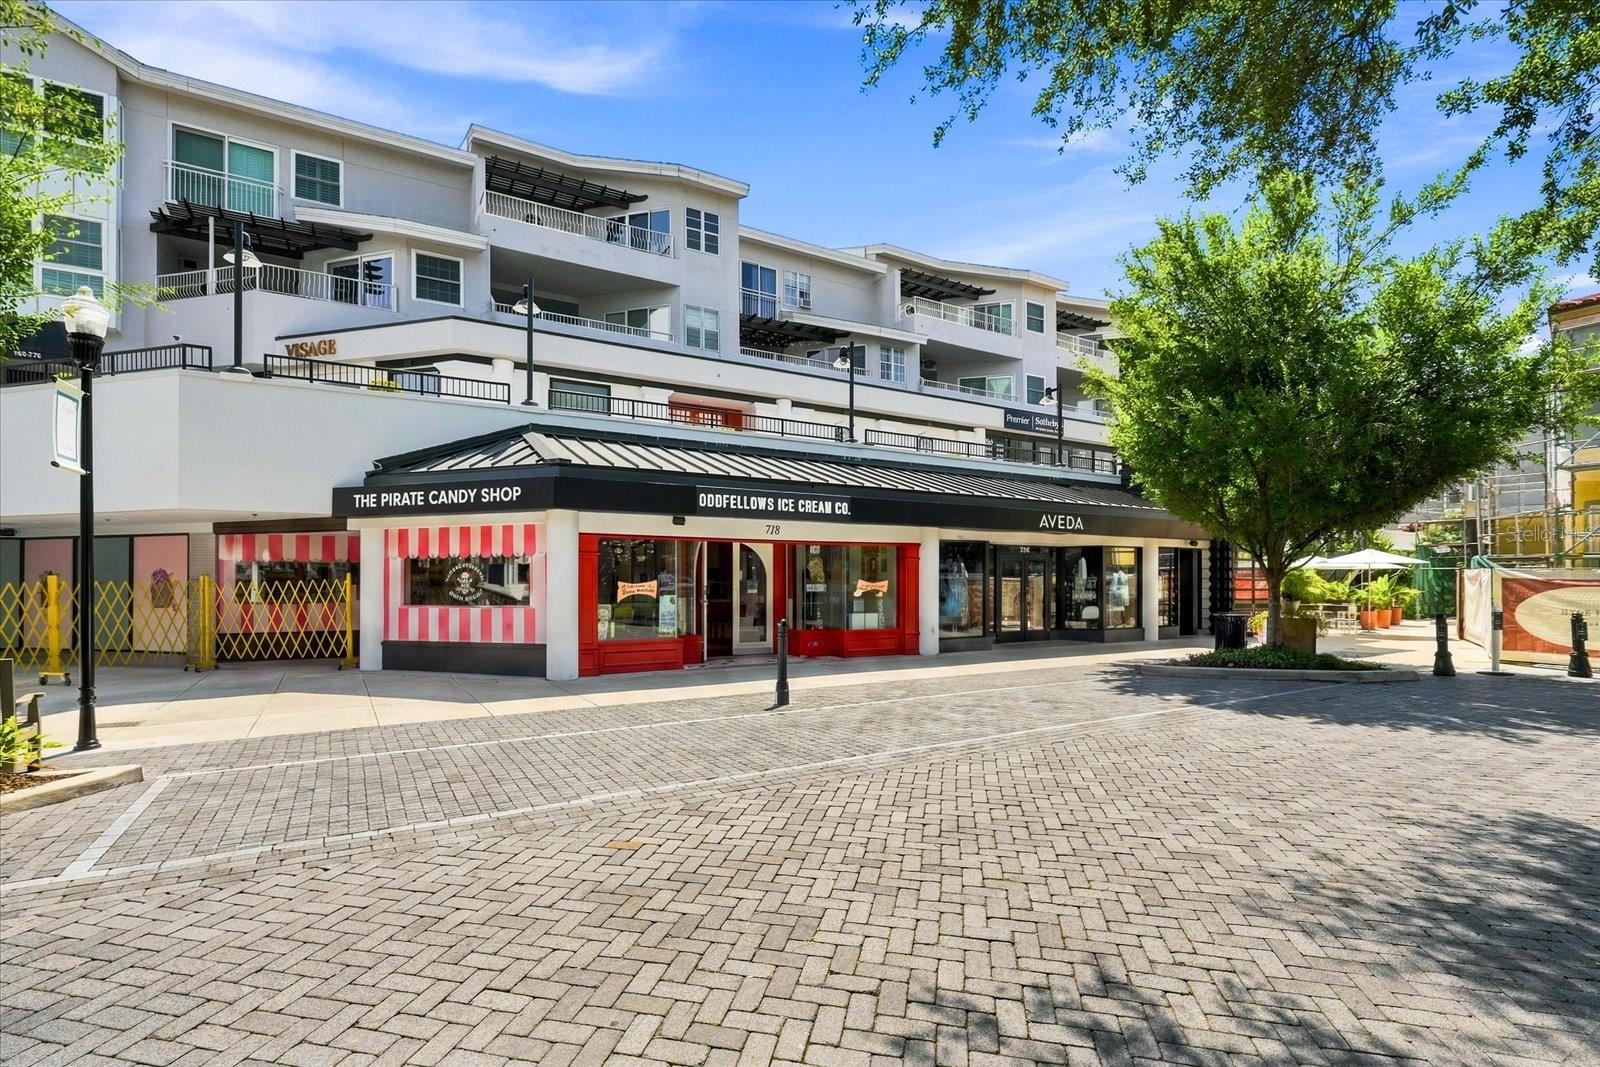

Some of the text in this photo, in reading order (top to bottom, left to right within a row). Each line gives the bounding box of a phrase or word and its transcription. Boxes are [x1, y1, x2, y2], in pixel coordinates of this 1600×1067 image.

[284, 339, 336, 357] VISAGE
[1006, 414, 1030, 425] Premier
[353, 486, 522, 508] THE PIRATE CANDY SHOP
[699, 493, 851, 515] ODDFELLOWS ICE CREAM CO.
[765, 525, 781, 535] 718
[1039, 513, 1084, 530] AVEDA
